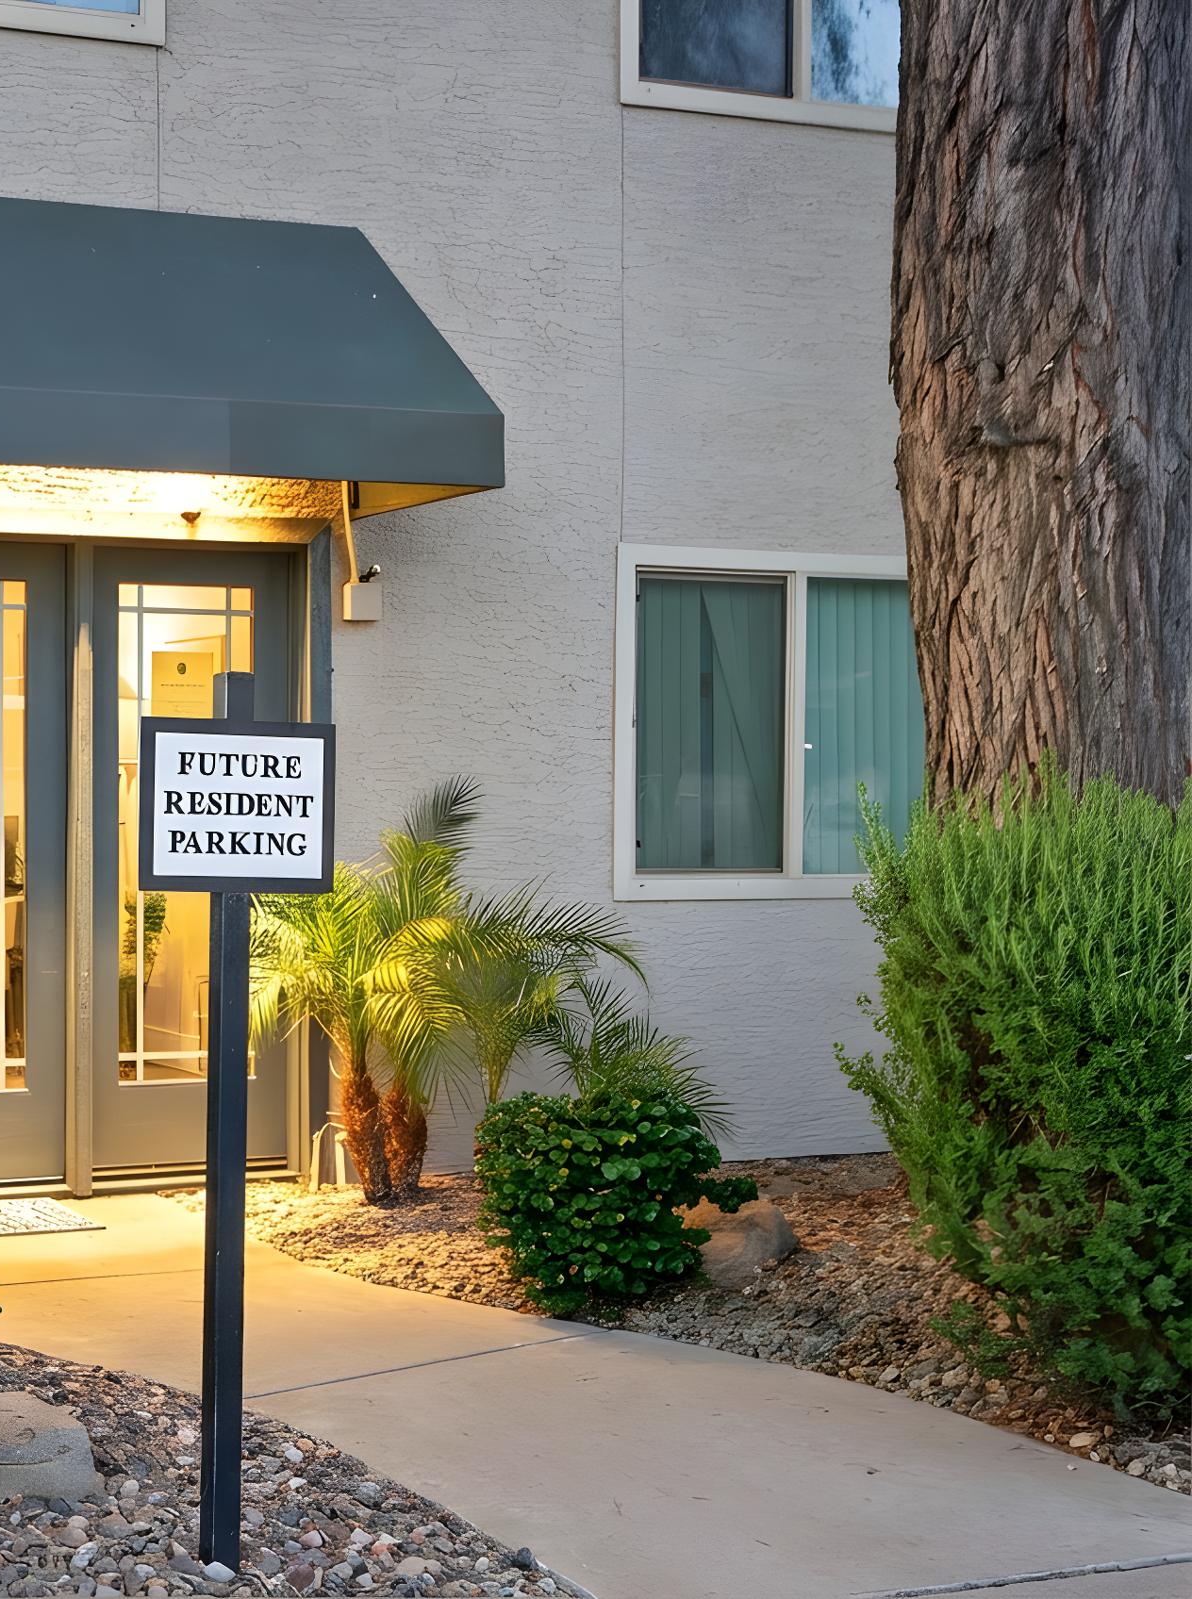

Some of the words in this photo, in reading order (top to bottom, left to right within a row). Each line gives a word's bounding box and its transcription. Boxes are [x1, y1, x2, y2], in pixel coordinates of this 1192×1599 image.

[177, 751, 302, 779] FUTURE
[163, 790, 314, 818] RESIDENT
[167, 830, 307, 856] PARKING
